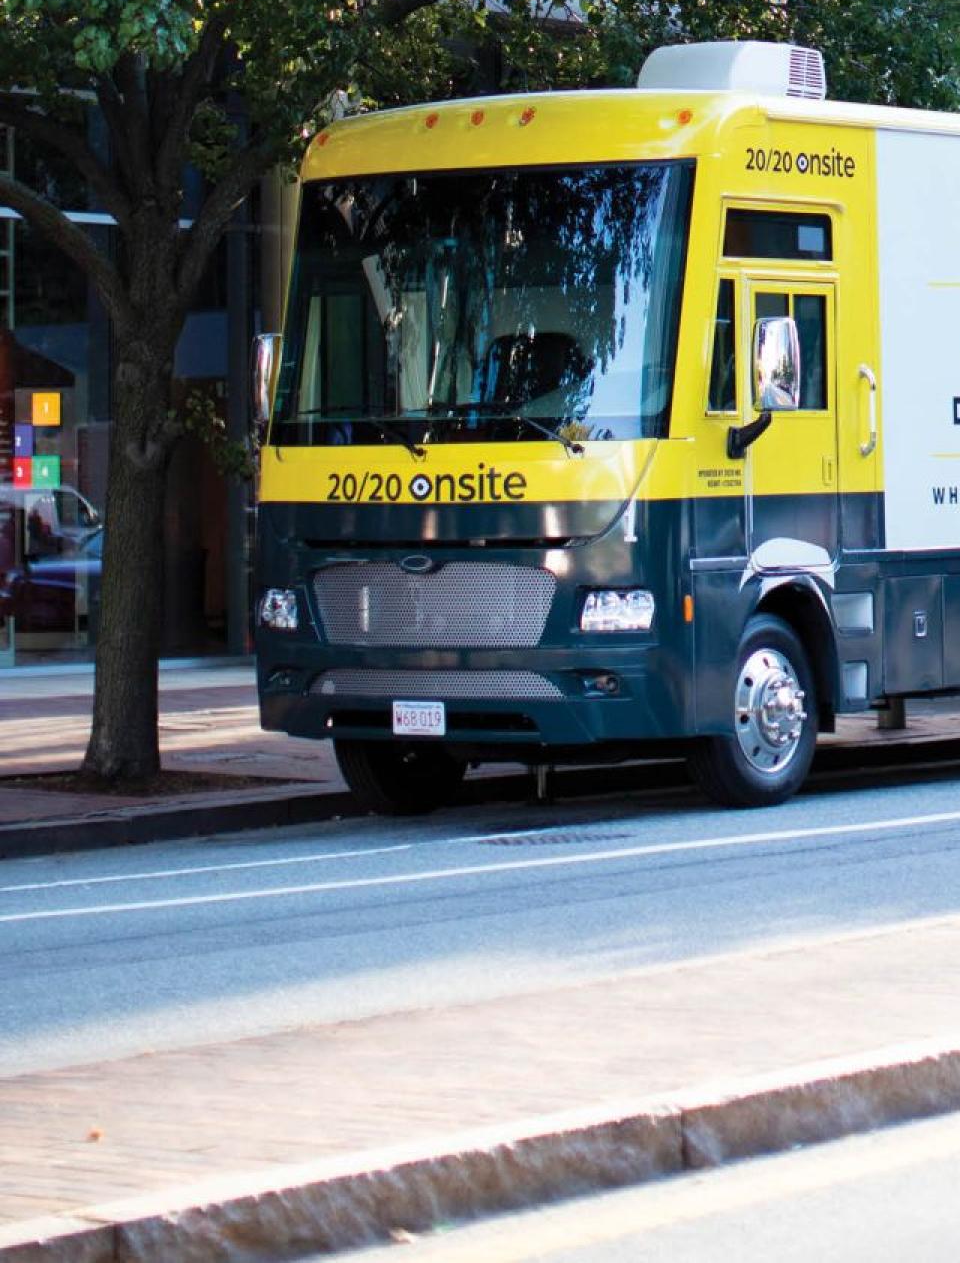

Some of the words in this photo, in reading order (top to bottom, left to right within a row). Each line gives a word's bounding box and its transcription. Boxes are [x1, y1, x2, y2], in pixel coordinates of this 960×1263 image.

[745, 148, 793, 174] 20/20
[796, 147, 856, 178] onsite
[327, 471, 403, 502] 20/20
[408, 462, 528, 502] onsite
